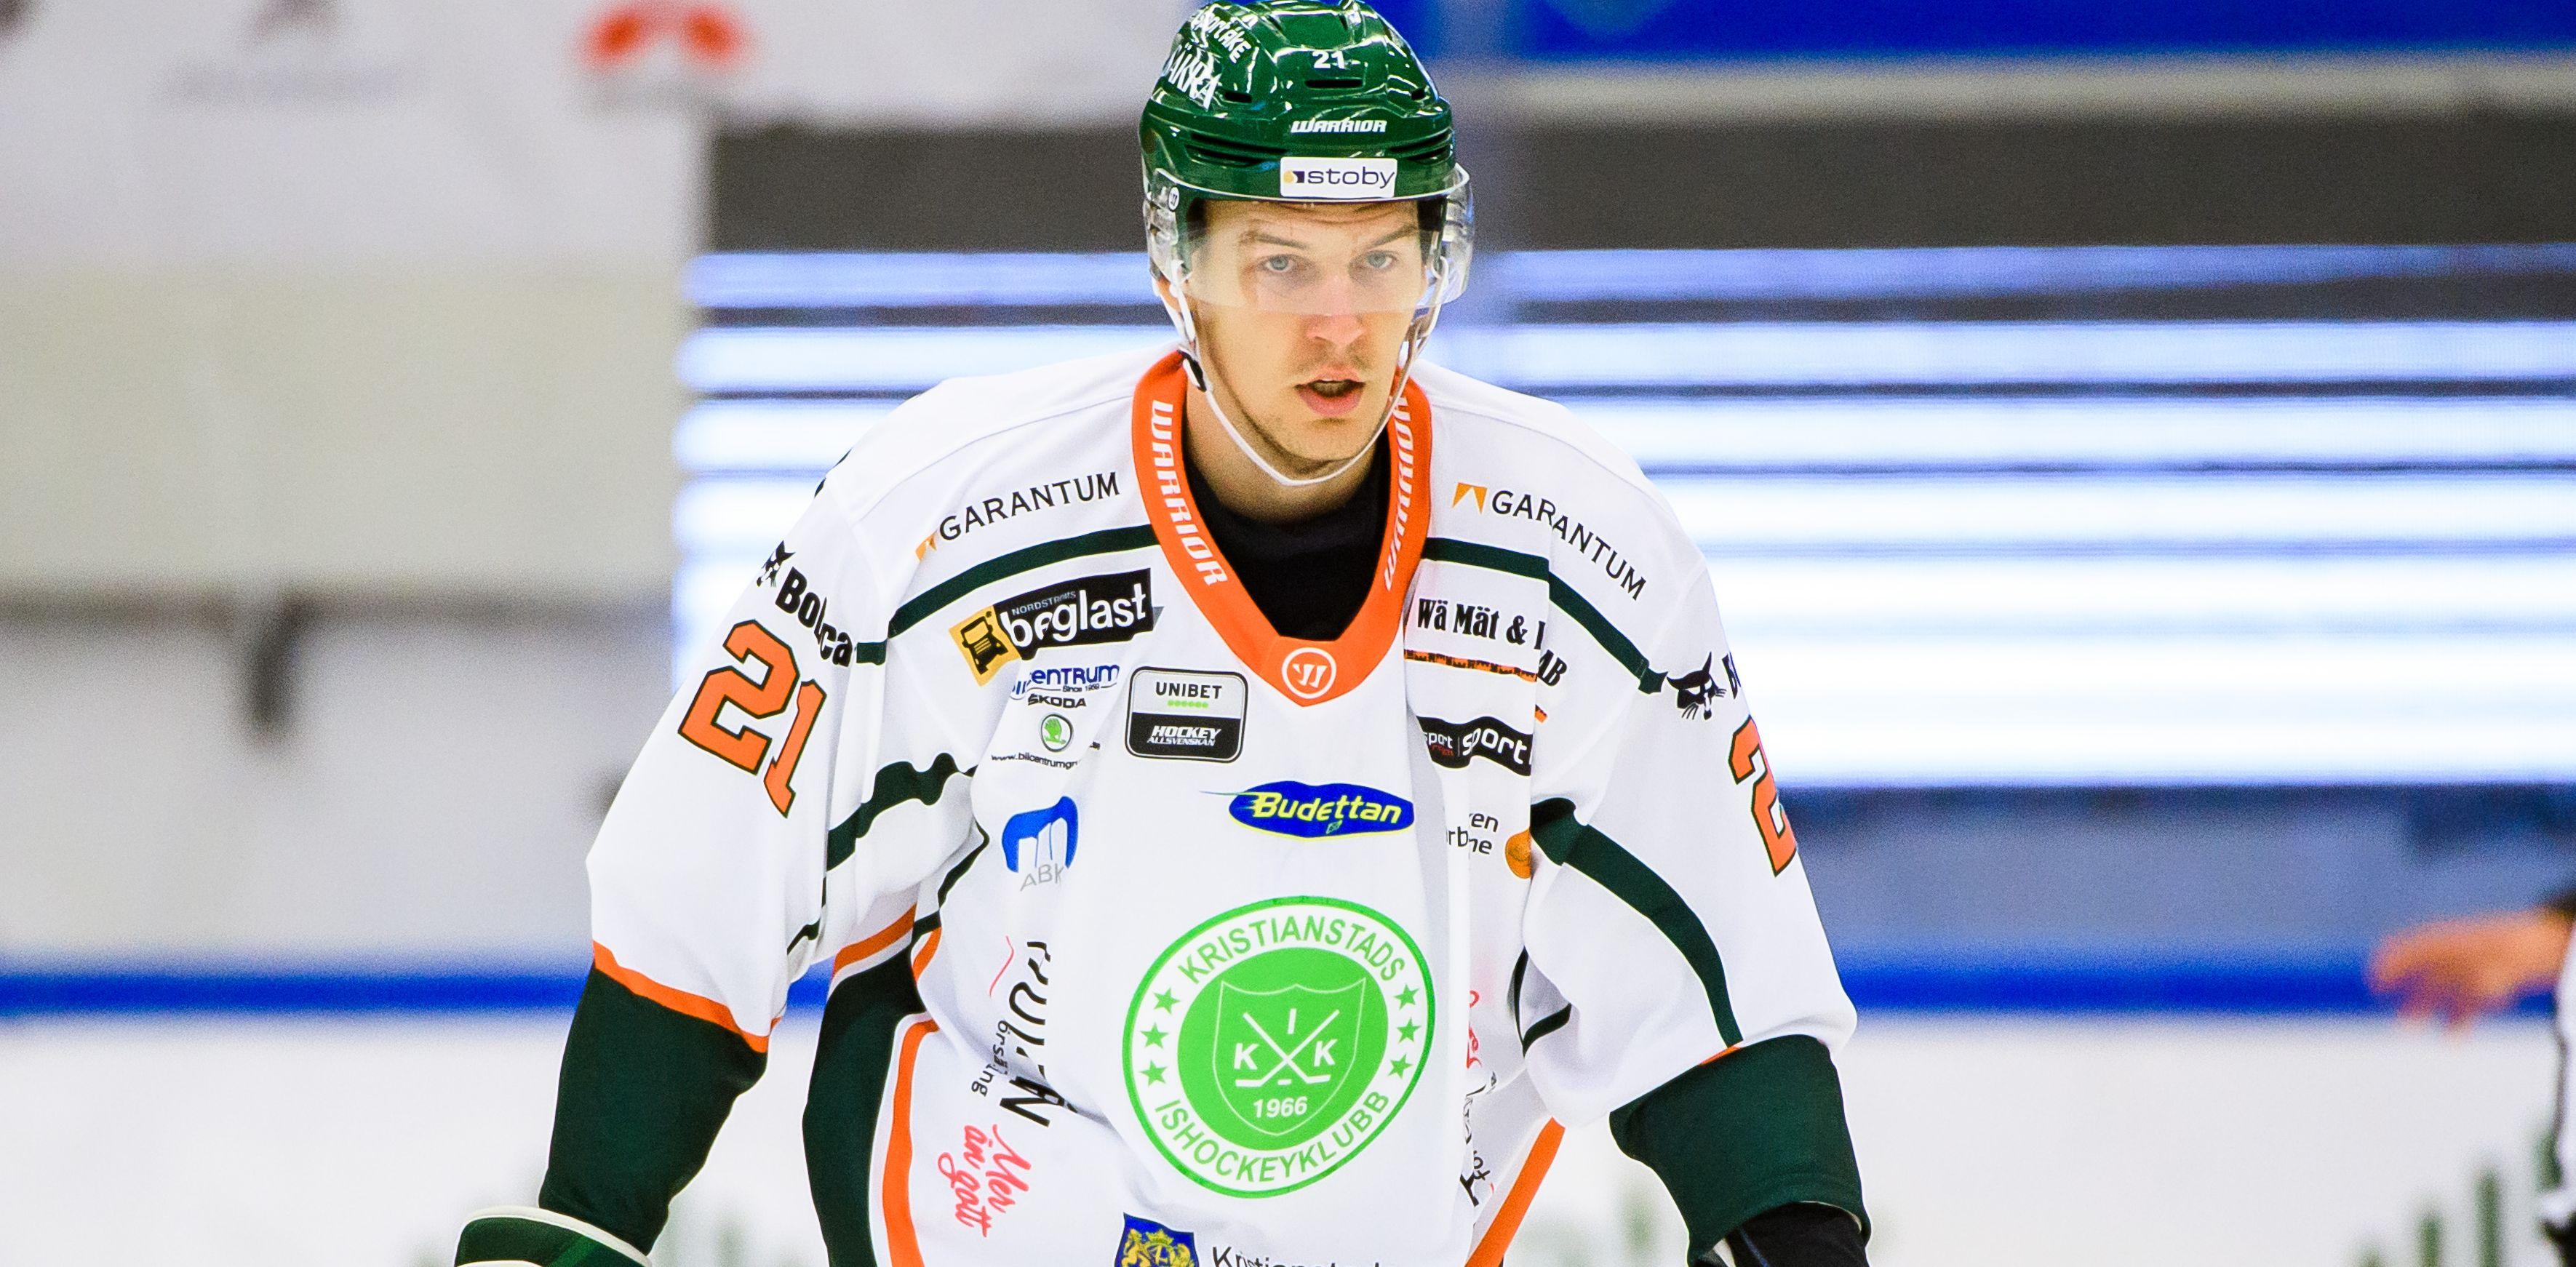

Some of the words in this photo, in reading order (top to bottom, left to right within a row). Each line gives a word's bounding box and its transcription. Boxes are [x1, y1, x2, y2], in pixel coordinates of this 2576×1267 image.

[1312, 52, 1345, 69] 21
[1291, 120, 1387, 133] WARRIOR
[1307, 167, 1396, 189] stoby
[939, 471, 1121, 541] GARANTUM
[1152, 400, 1228, 586] WARRIOR
[1492, 489, 1647, 601] GARANTUM
[1453, 603, 1500, 640] Mät
[1506, 615, 1528, 645] &
[1028, 693, 1087, 709] ŠKODA
[1155, 682, 1222, 700] UNIBET
[678, 619, 827, 819] 21
[1151, 725, 1221, 740] HOCKEY
[1251, 791, 1402, 824] Budettan
[1177, 915, 1405, 984] KRISTIANSTADS
[1253, 1096, 1308, 1118] 1966
[1155, 1091, 1389, 1183] ISHOCKEYKLUBB
